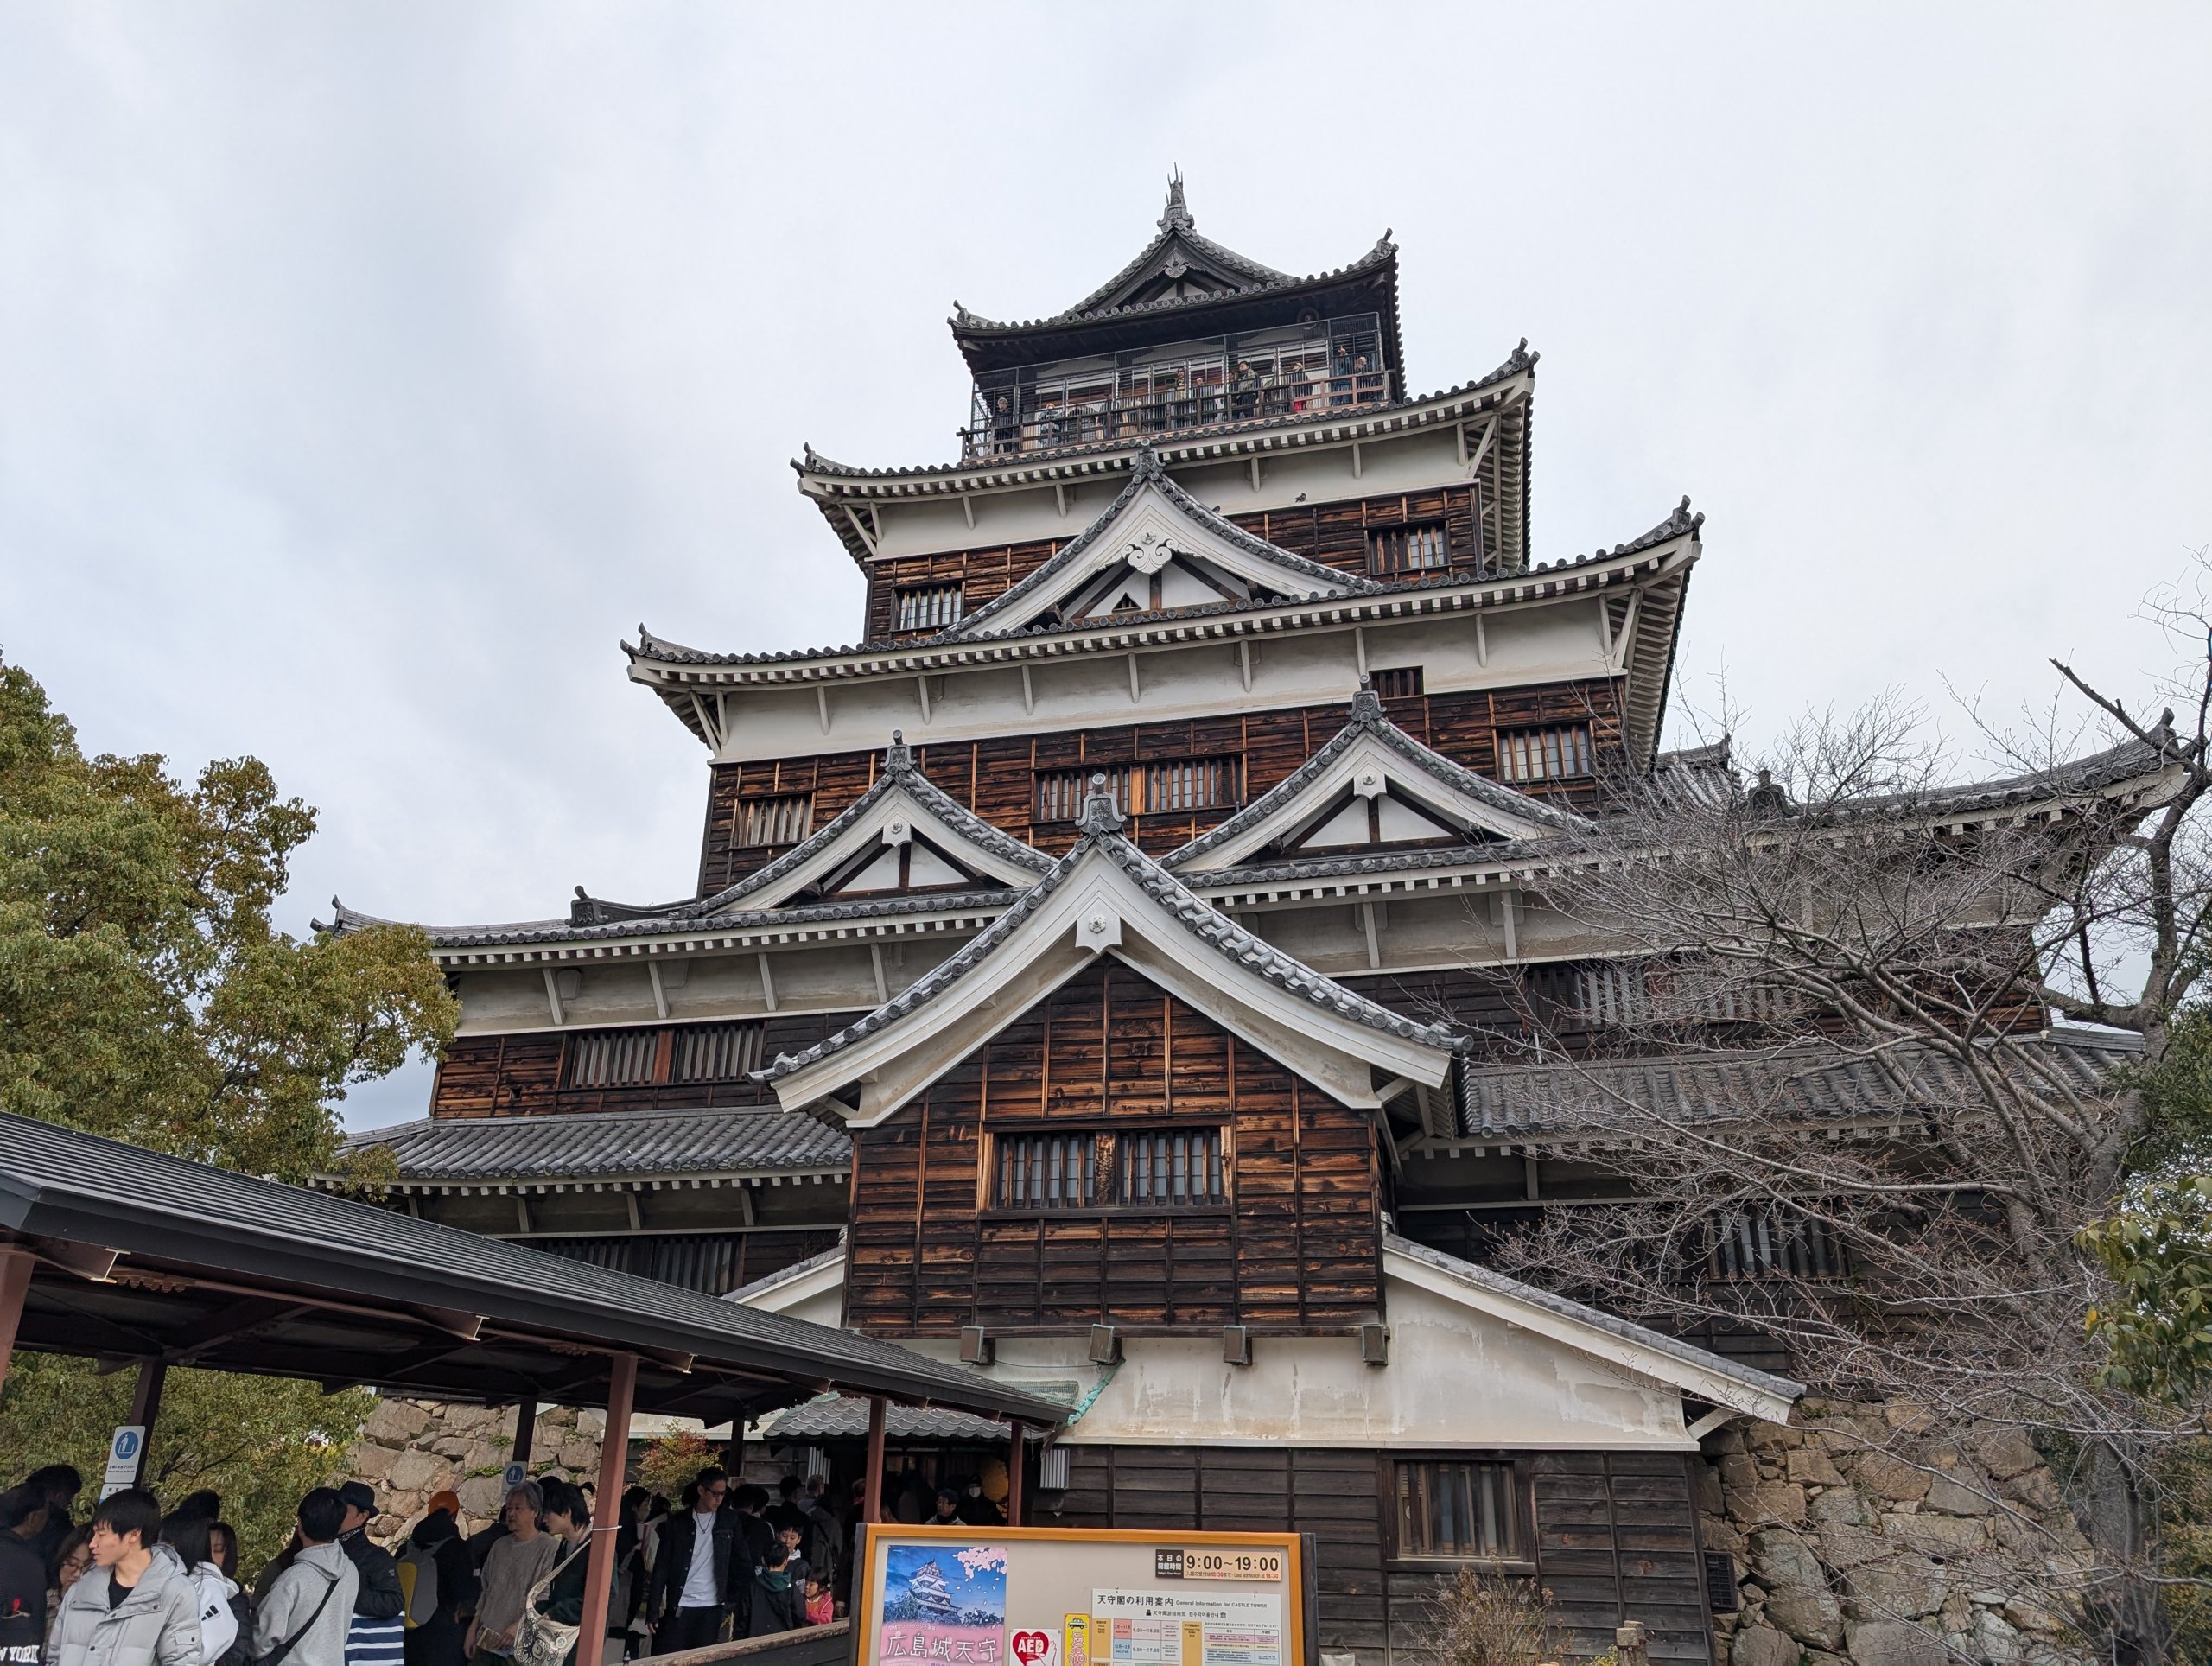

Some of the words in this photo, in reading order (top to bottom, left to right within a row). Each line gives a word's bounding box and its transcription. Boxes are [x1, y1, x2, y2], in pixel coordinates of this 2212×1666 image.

[1186, 1555, 1279, 1572] 9:00～19:00
[1097, 1595, 1173, 1606] 天守閣の利用案内
[9, 1644, 40, 1664] YORK
[887, 1632, 997, 1664] 広島城天守
[1017, 1638, 1044, 1653] AED
